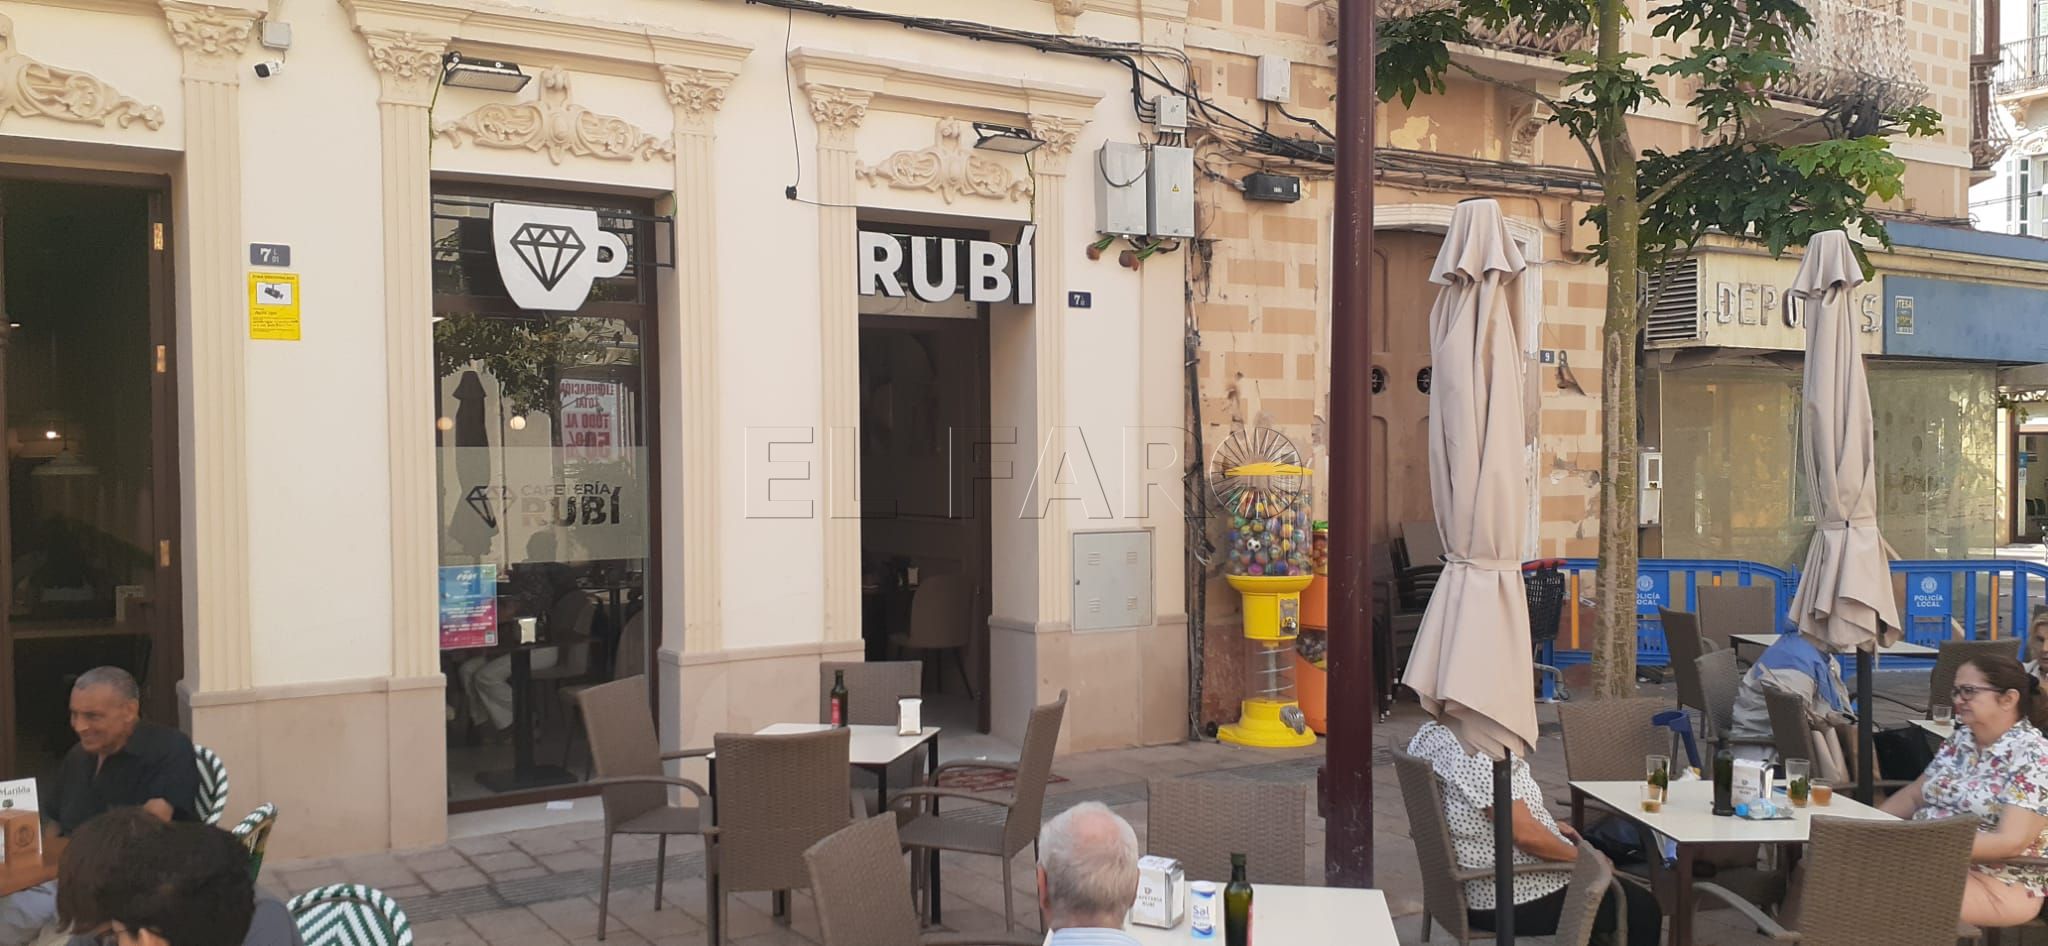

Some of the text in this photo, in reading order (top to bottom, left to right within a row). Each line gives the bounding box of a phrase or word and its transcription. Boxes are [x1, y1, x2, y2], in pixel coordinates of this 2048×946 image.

[260, 247, 271, 262] 7
[858, 224, 1037, 304] RUBÍ
[1073, 294, 1081, 305] 7
[1716, 281, 1881, 333] DEPOS
[1544, 352, 1550, 362] 9
[520, 486, 622, 527] RUBÍ
[1193, 905, 1209, 915] Sal
